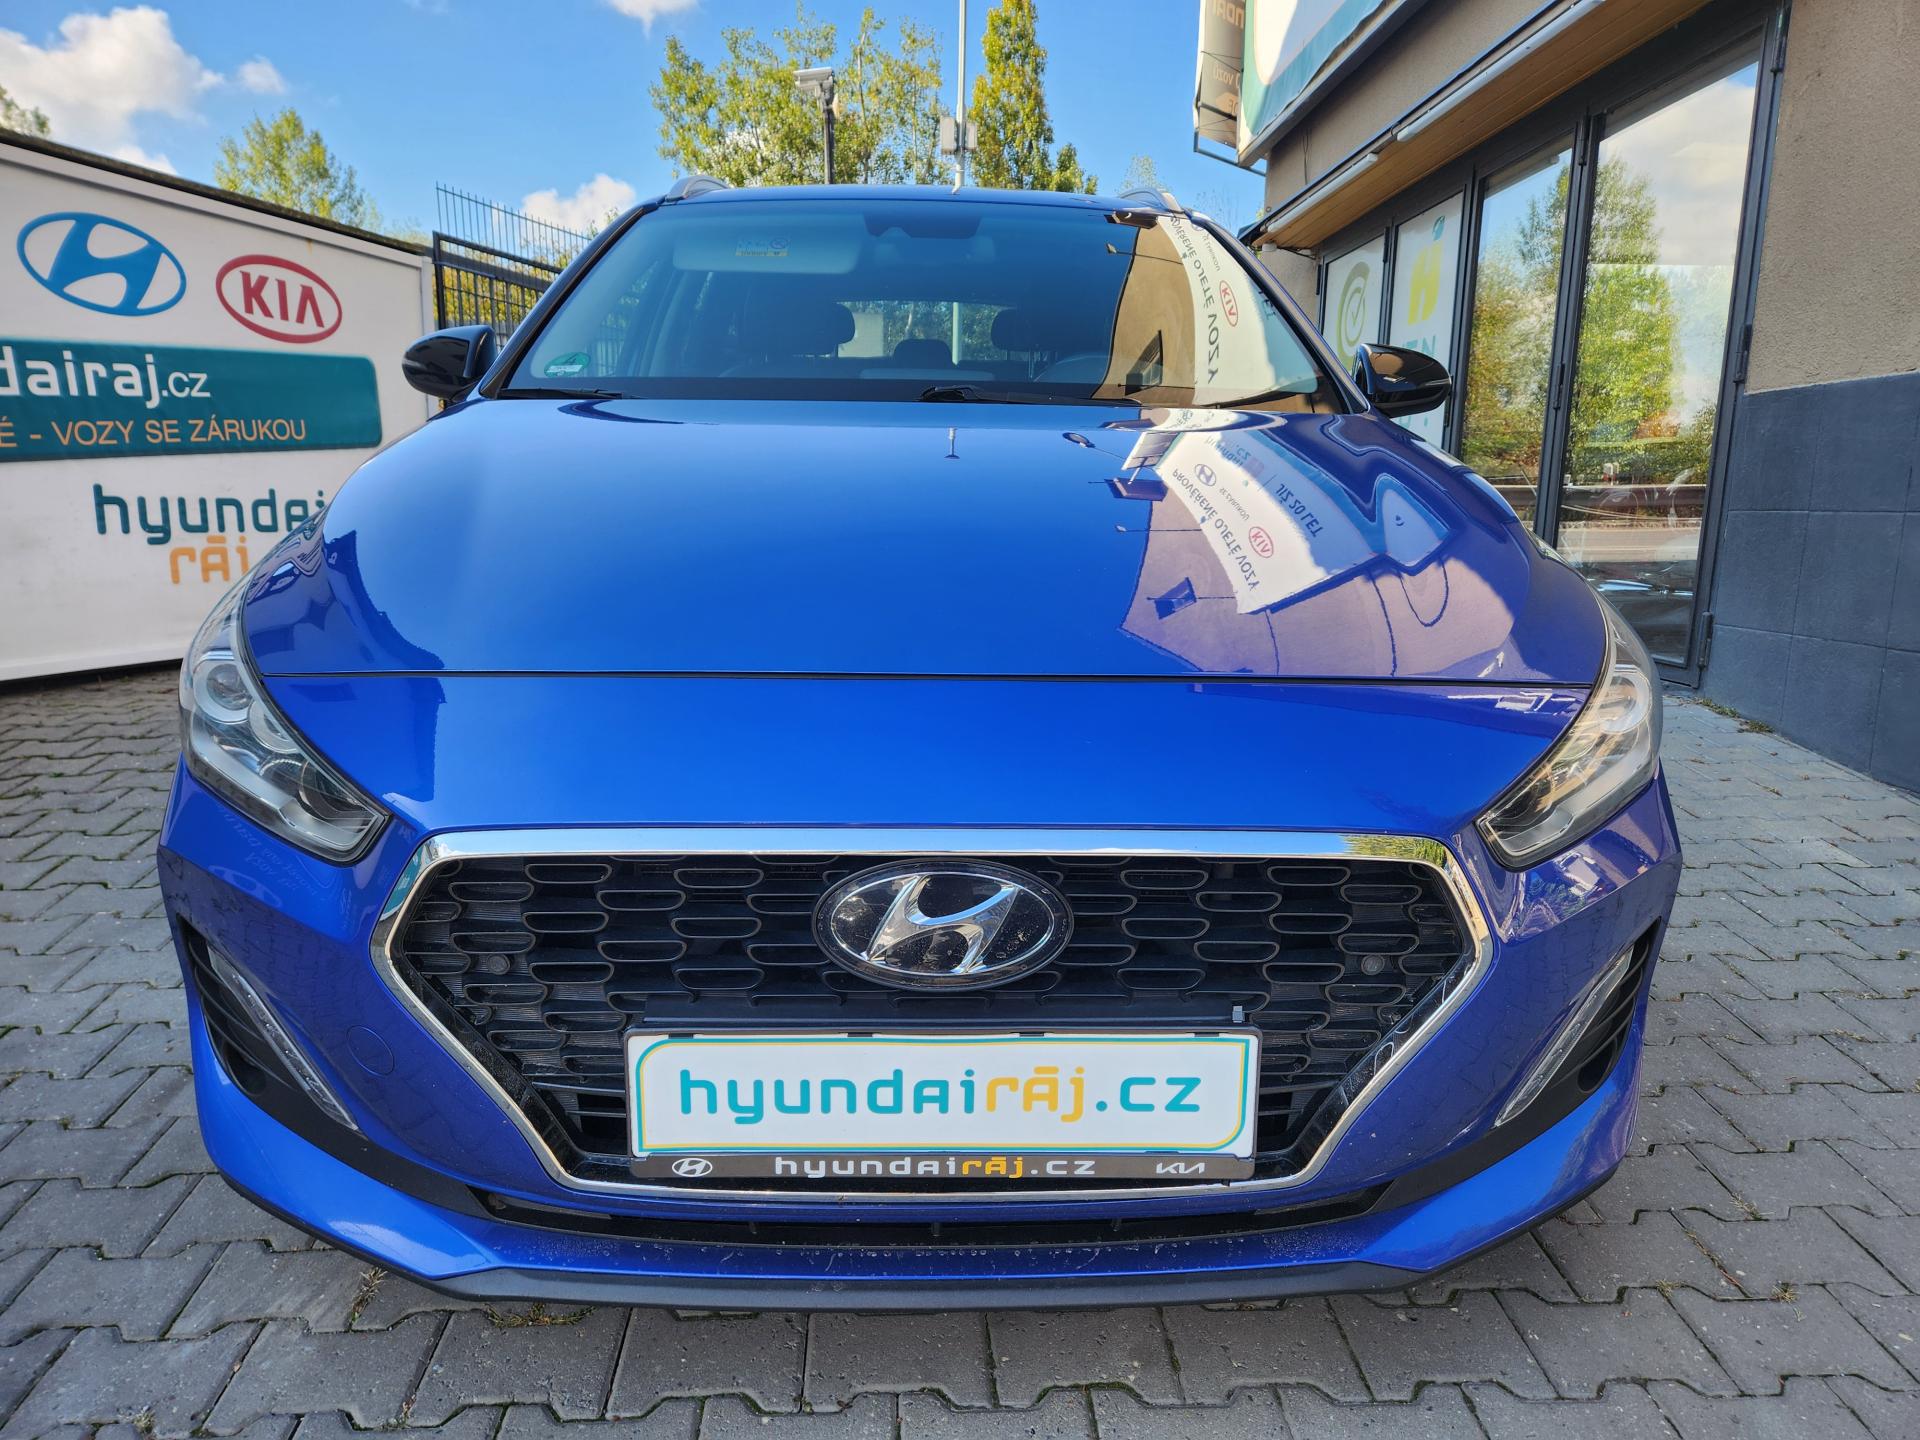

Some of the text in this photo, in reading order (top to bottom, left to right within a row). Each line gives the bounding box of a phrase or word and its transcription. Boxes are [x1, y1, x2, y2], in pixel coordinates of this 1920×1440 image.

[238, 270, 325, 329] KIA
[50, 419, 135, 446] VOZY
[145, 419, 181, 443] SE
[190, 413, 307, 442] ZÁRUKOU
